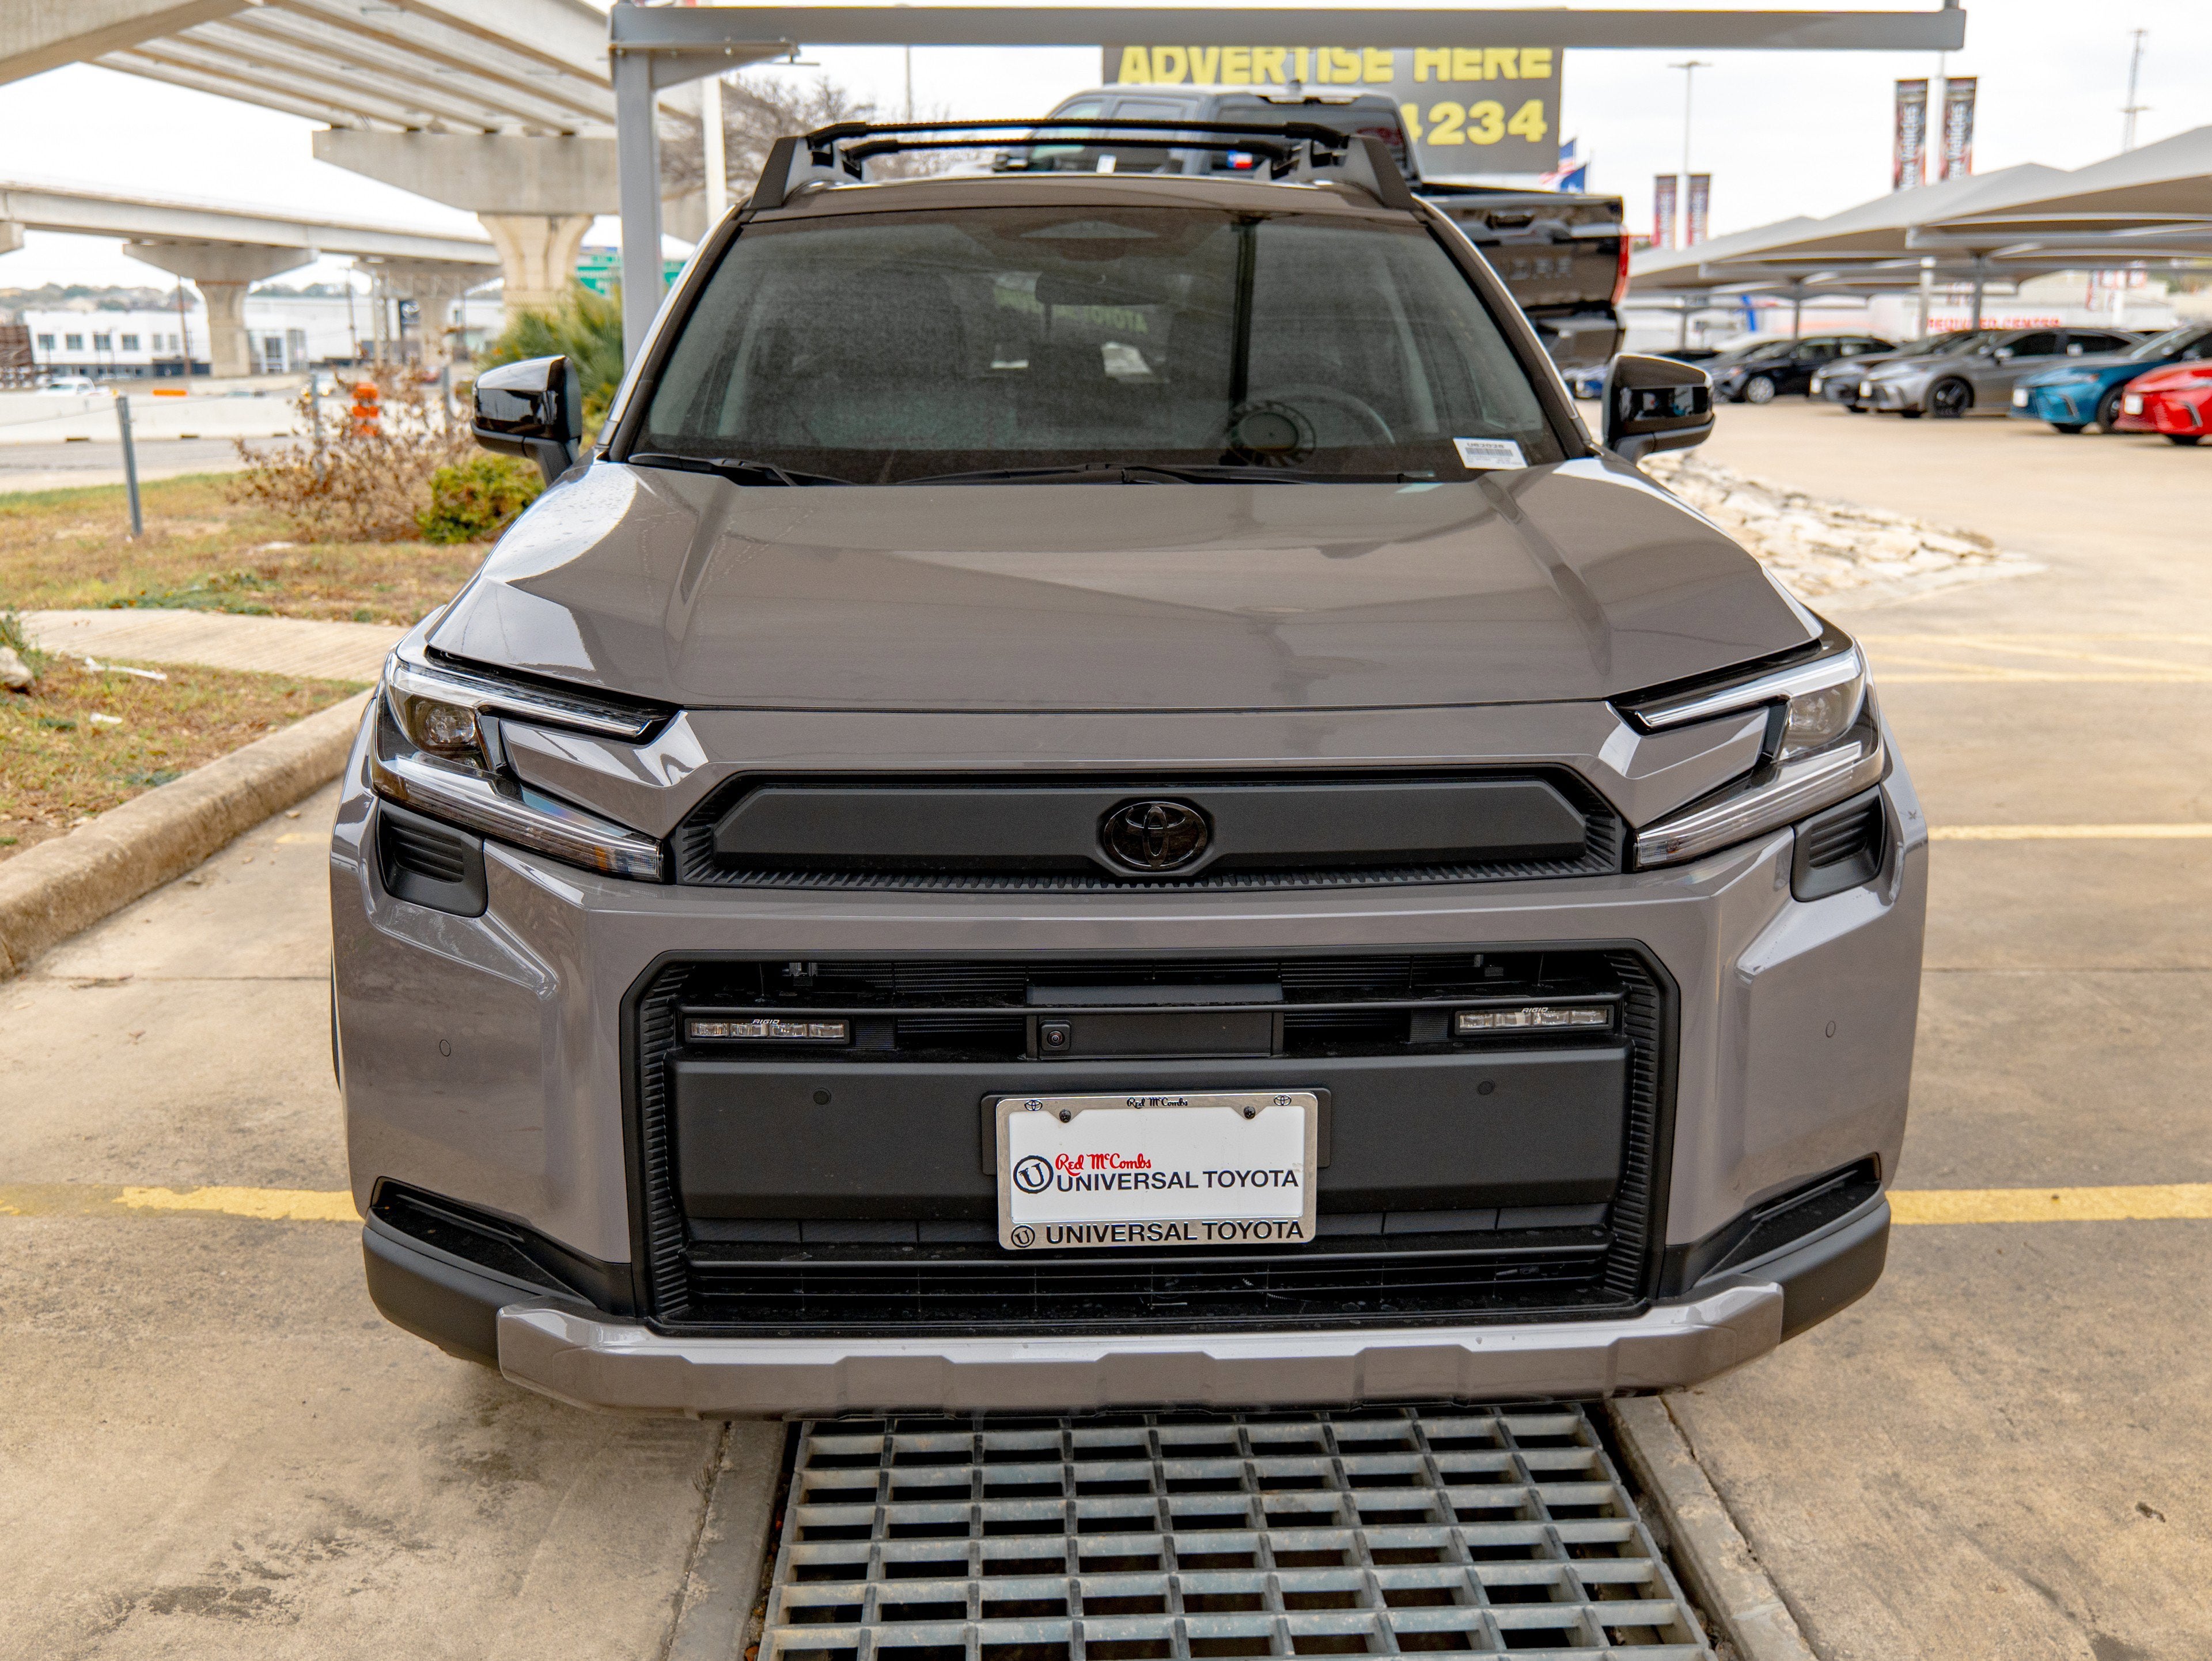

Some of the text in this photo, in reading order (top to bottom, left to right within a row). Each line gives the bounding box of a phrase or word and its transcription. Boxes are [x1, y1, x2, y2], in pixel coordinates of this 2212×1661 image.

[1118, 46, 1552, 85] ADVERTISE HERE
[1127, 1096, 1188, 1109] Red McCombs
[1055, 1153, 1152, 1176] Red McCombs
[1057, 1170, 1299, 1192] UNIVERSAL TOYOTA
[1046, 1220, 1304, 1244] UNIVERSAL TOYOTA
